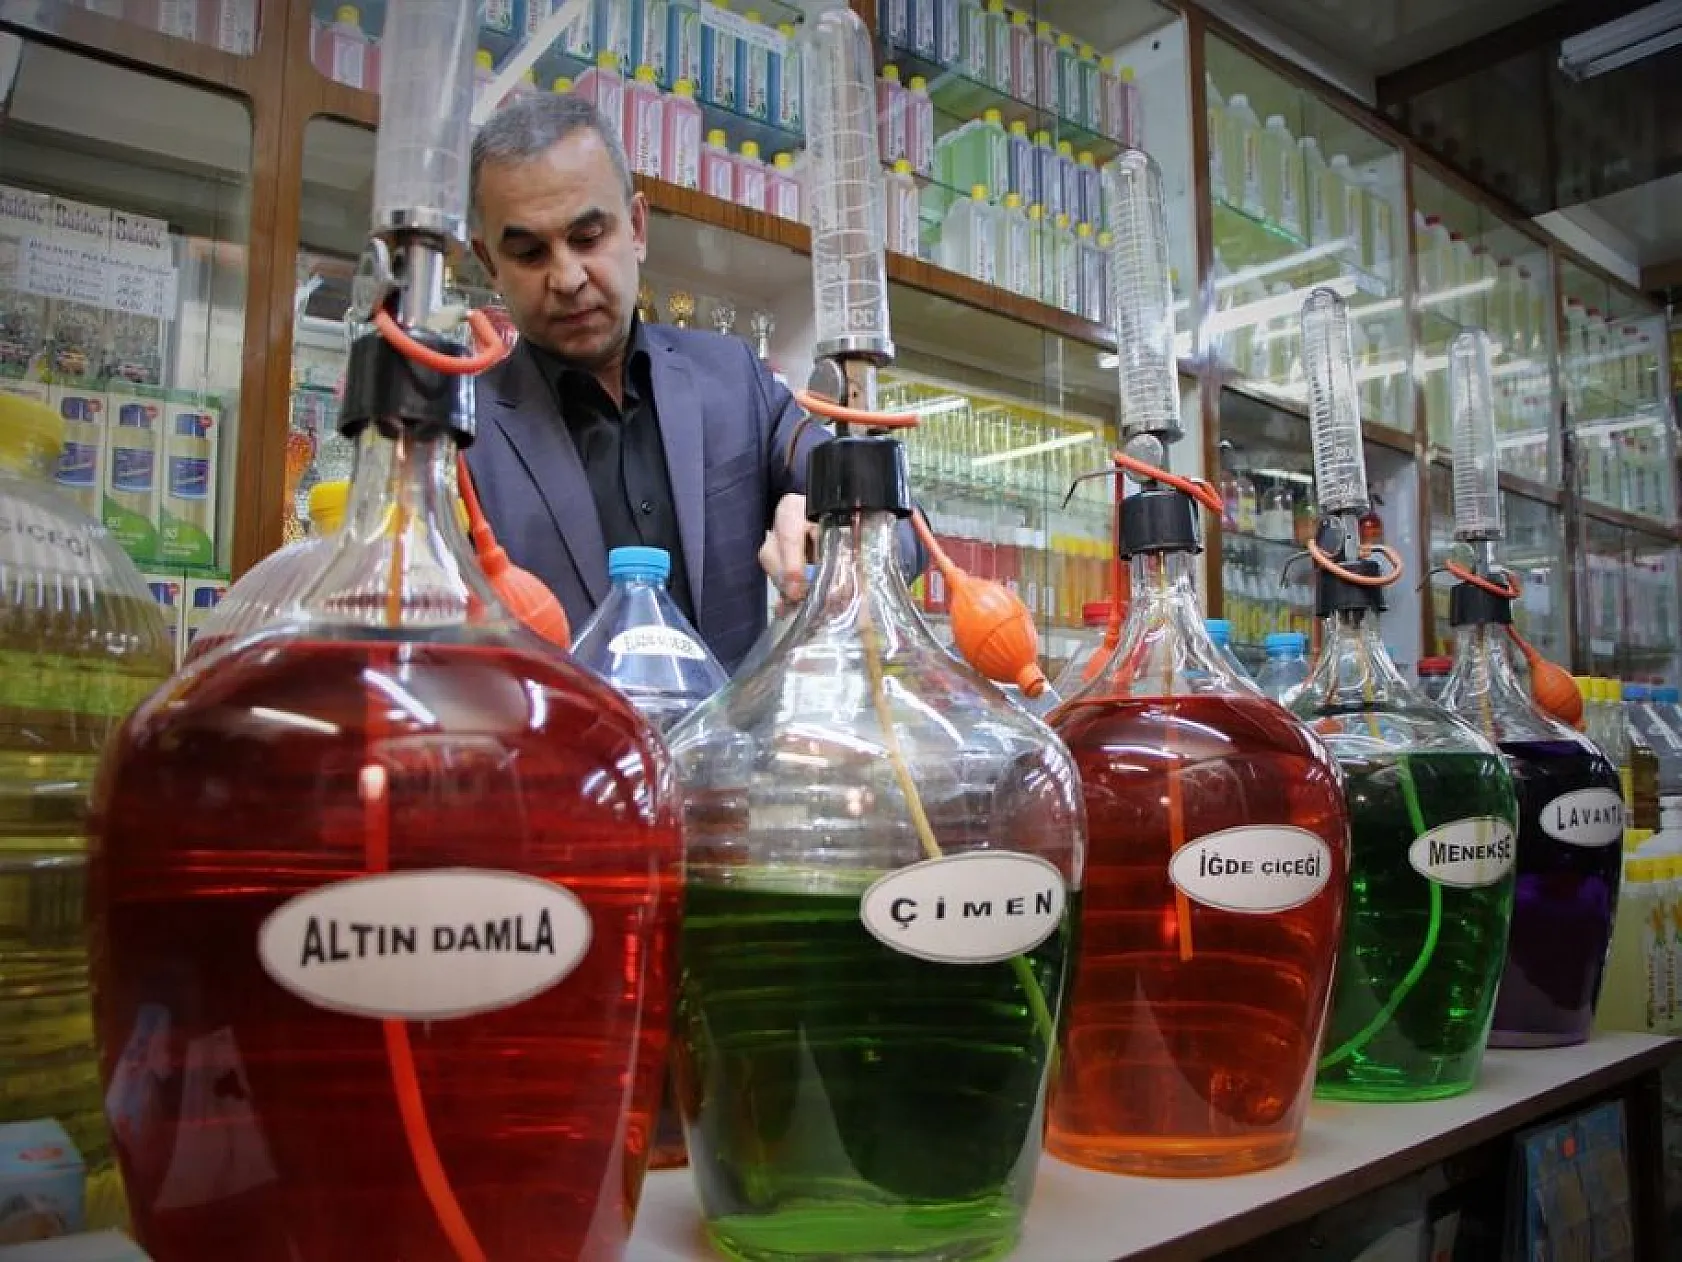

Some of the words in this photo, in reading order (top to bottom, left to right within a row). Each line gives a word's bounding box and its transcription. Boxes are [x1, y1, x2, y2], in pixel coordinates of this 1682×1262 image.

[1200, 848, 1254, 877] İĞDE
[1428, 834, 1511, 867] MENEKŞE
[890, 889, 1052, 930] ÇİMEN
[301, 915, 417, 967] ALTIN
[431, 907, 556, 956] DAMLA
